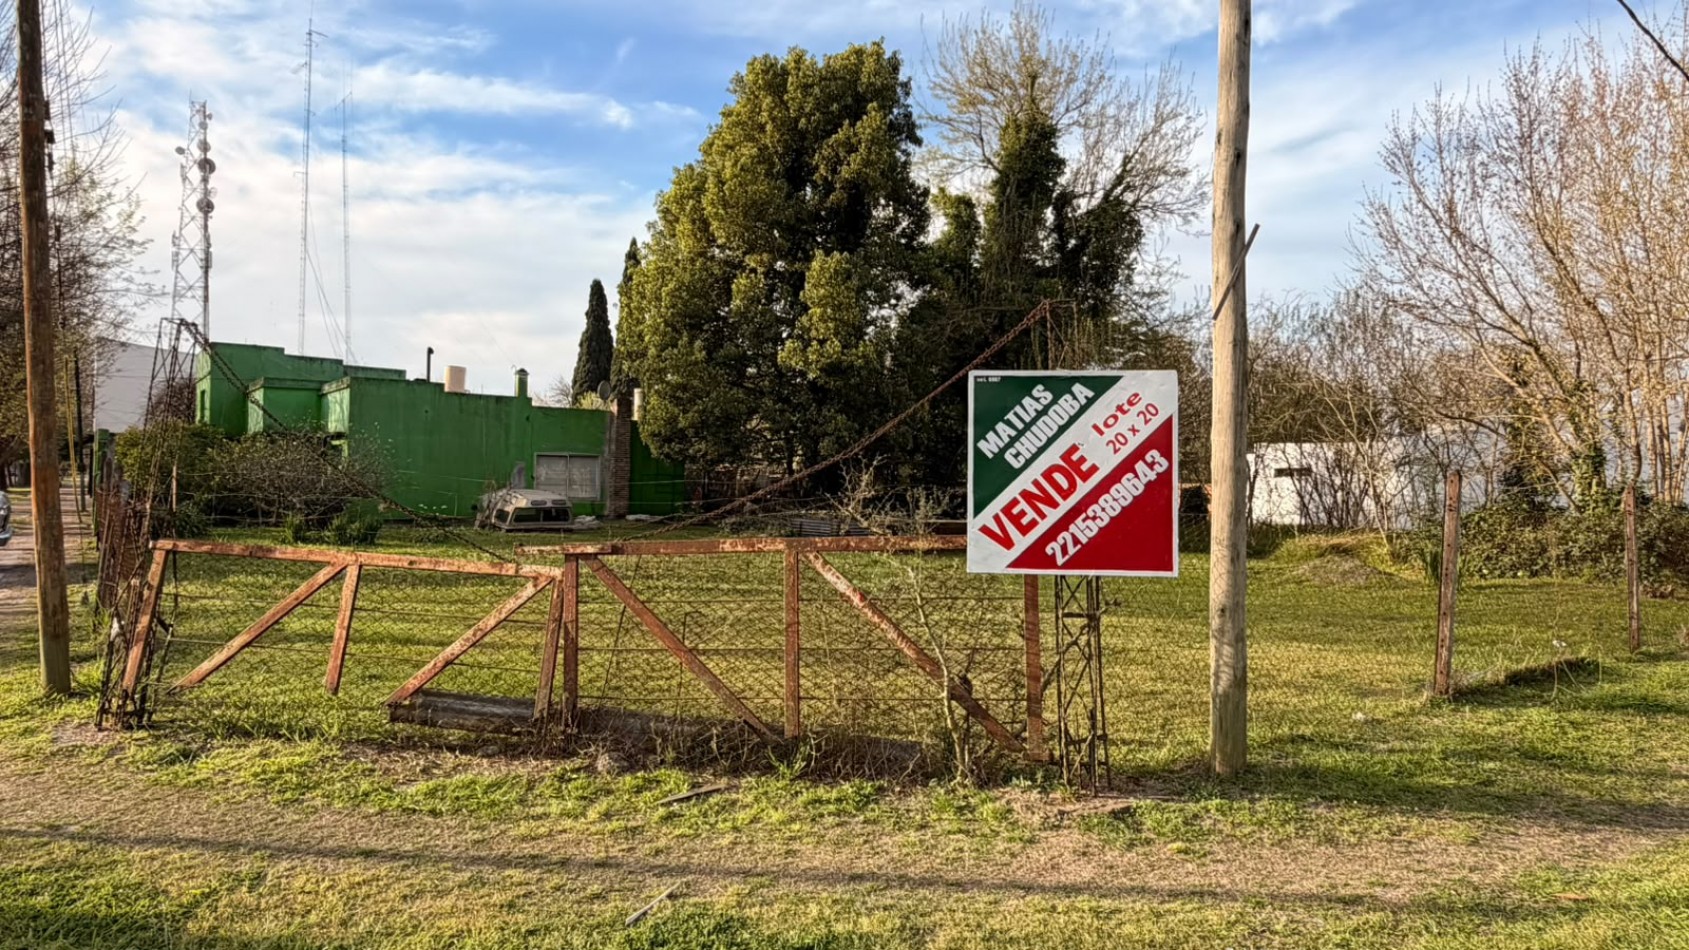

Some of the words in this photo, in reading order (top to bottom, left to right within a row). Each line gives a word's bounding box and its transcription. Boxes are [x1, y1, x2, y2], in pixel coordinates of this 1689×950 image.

[977, 384, 1053, 459] MATIAS
[1004, 382, 1095, 469] CHUDOBA
[1092, 392, 1142, 436] lote
[1106, 432, 1128, 455] 20
[1128, 424, 1140, 436] x
[1137, 403, 1159, 426] 20
[979, 443, 1100, 551] VENDE
[1045, 449, 1169, 566] 2215389643
